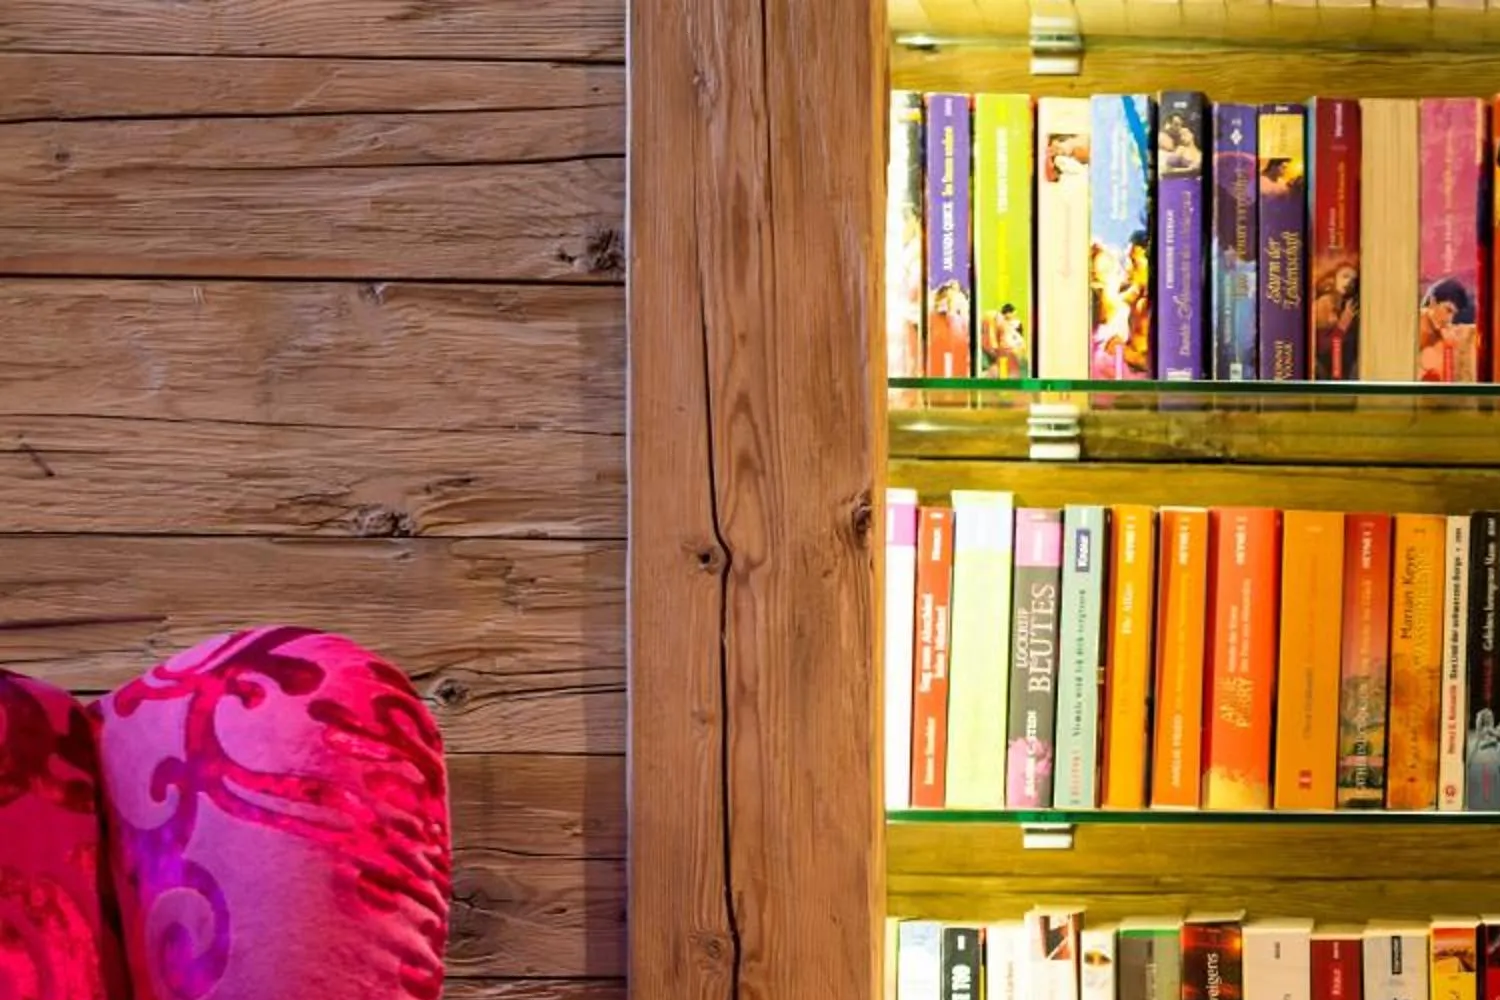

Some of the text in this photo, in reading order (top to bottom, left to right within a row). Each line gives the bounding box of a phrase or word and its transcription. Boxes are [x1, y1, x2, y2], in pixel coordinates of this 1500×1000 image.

[1266, 262, 1281, 304] Sturm
[1281, 230, 1300, 310] Leidenschaft
[1399, 544, 1417, 640] Marian Keyes
[1027, 582, 1055, 693] BLUTES
